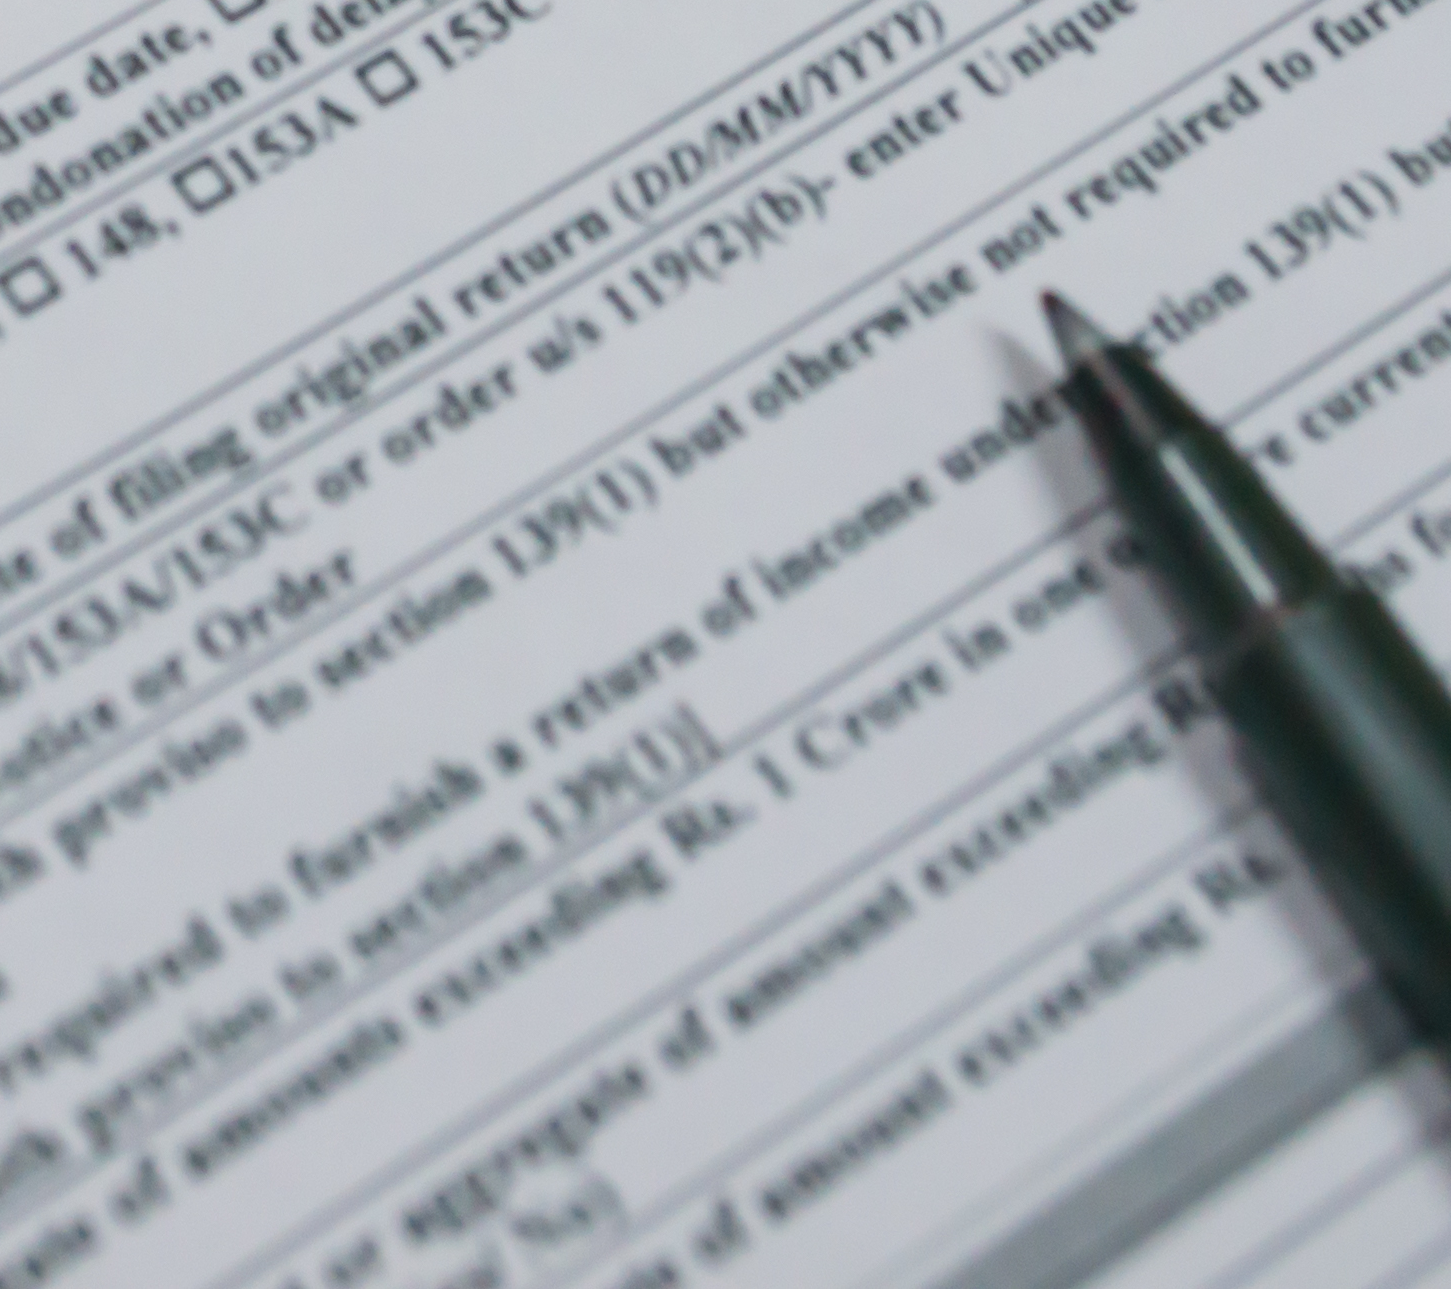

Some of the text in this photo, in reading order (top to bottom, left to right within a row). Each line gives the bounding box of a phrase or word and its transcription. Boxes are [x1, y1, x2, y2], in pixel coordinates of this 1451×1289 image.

[81, 20, 214, 101] date,
[246, 19, 306, 83] of
[62, 200, 183, 282] 148,
[223, 92, 362, 188] 153A
[598, 172, 837, 327] 119(2)(b)-
[840, 85, 965, 183] enter
[448, 205, 615, 321] return
